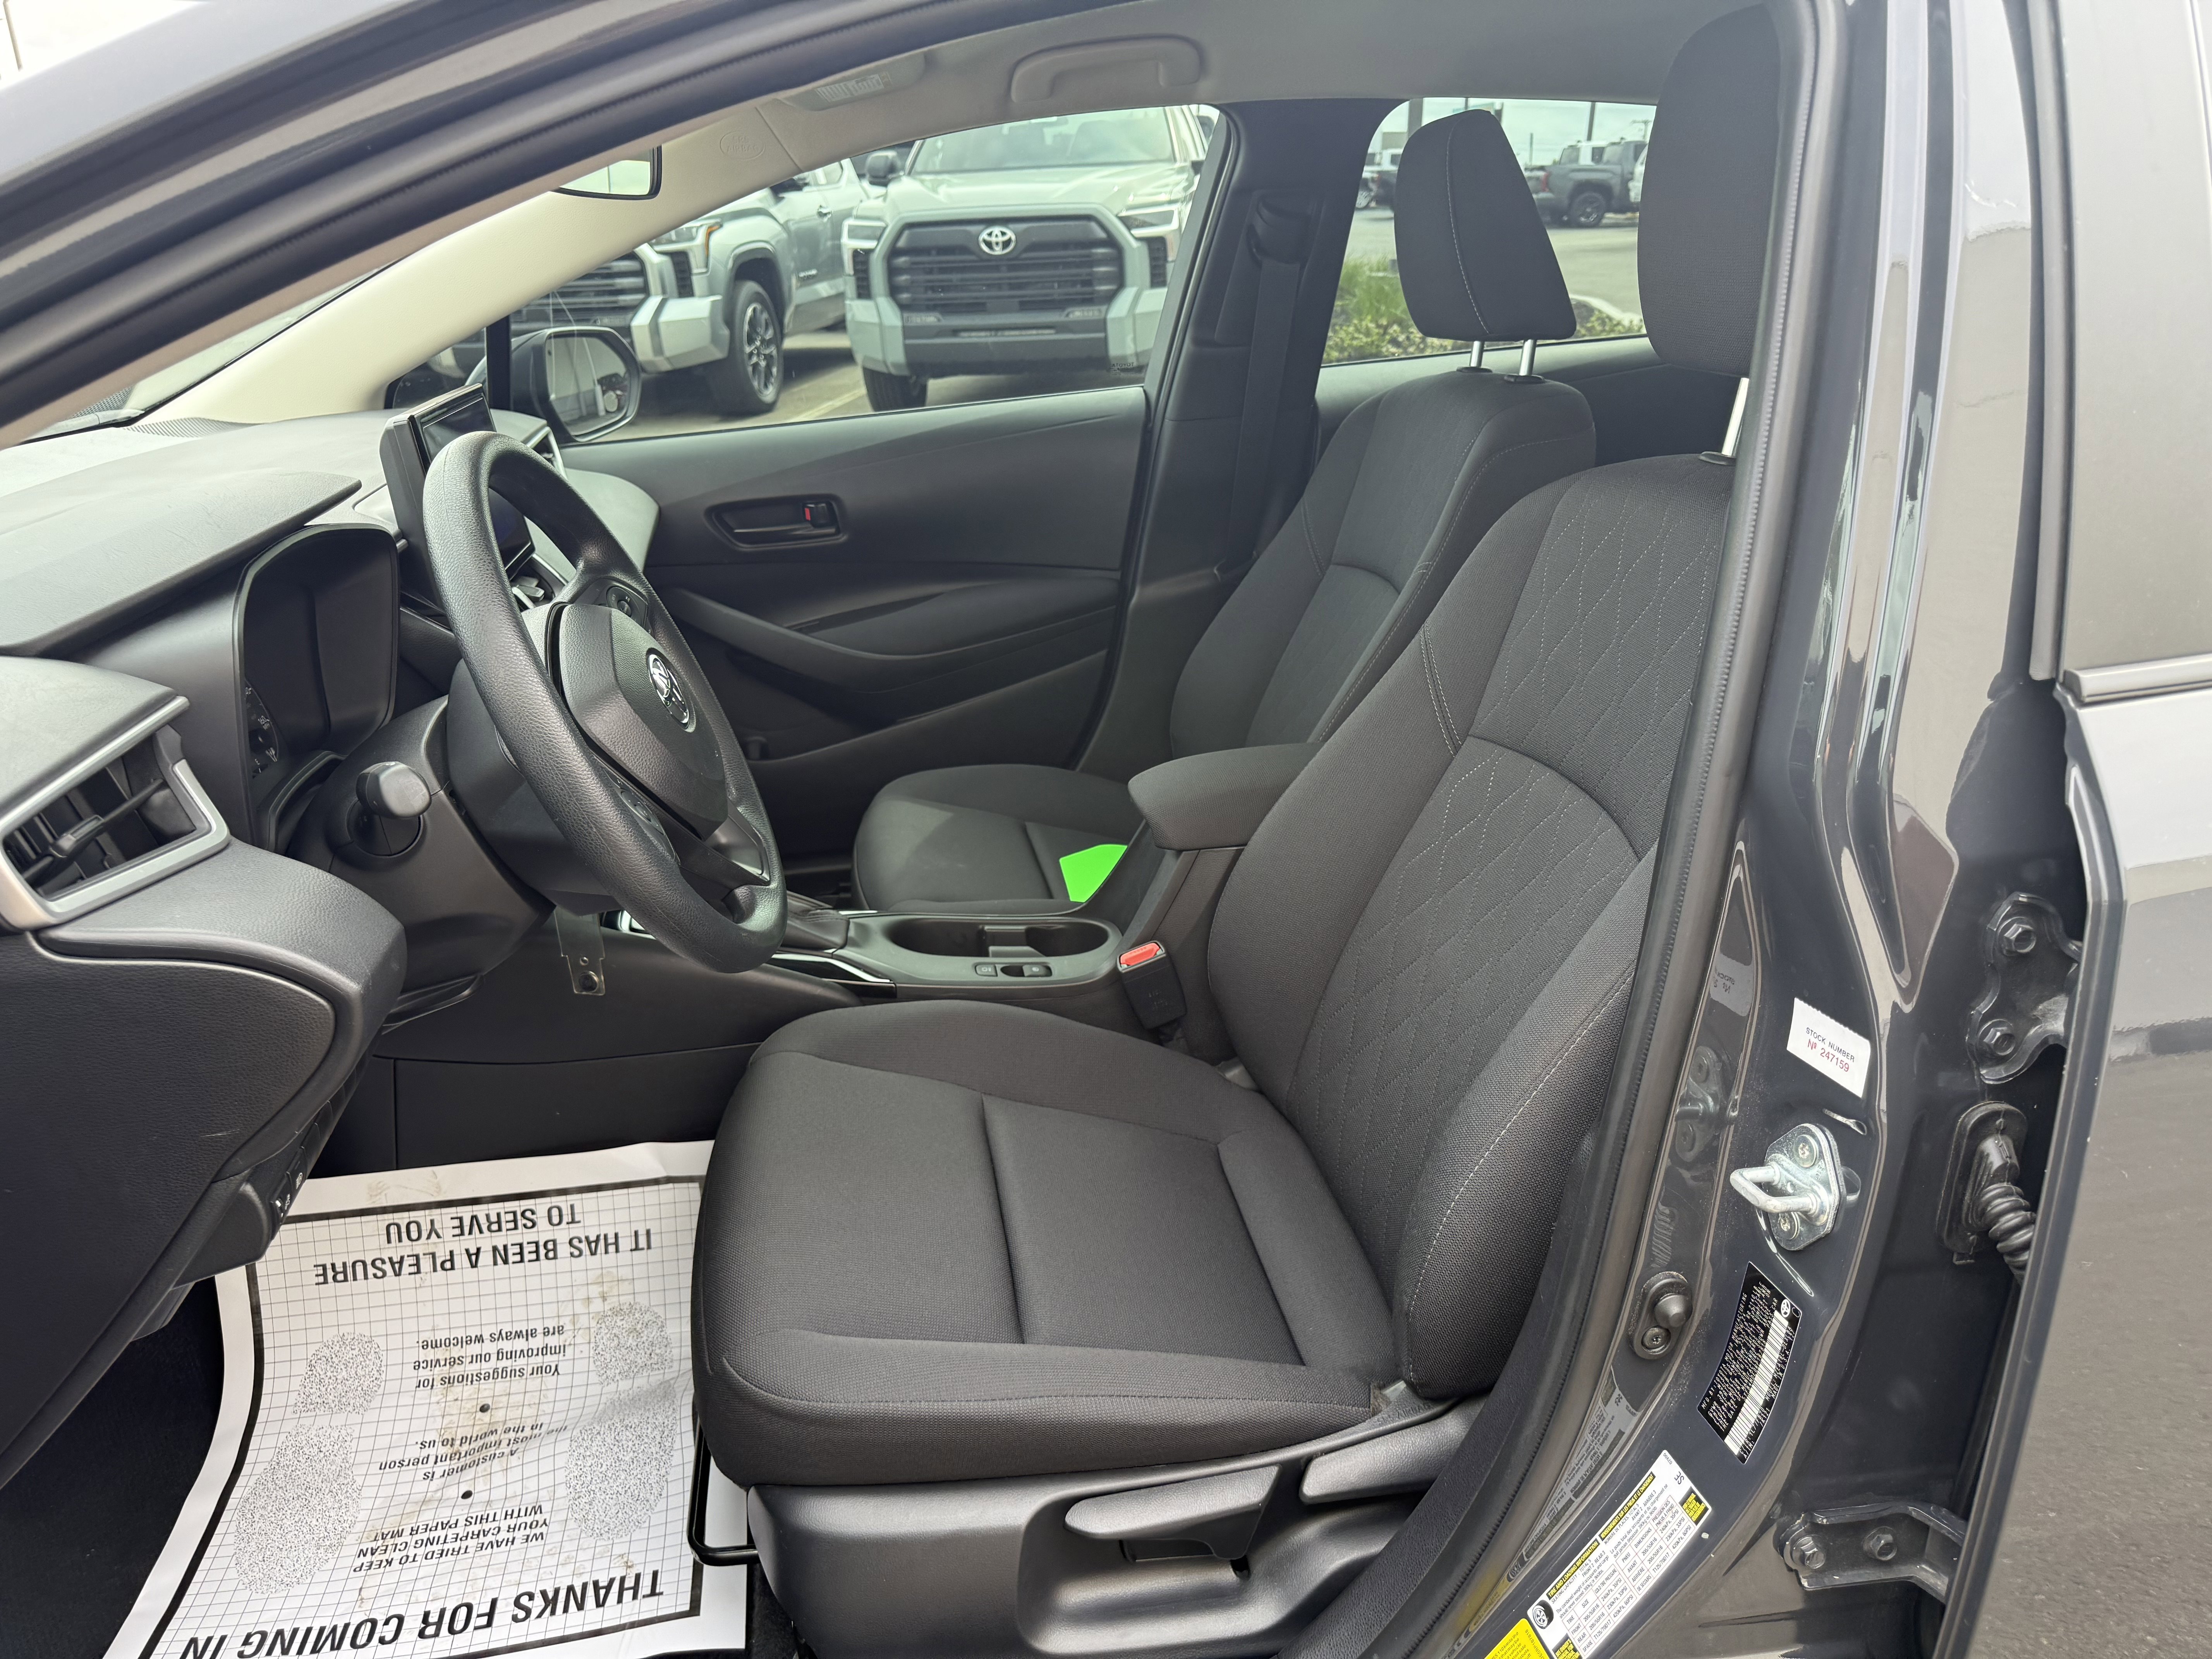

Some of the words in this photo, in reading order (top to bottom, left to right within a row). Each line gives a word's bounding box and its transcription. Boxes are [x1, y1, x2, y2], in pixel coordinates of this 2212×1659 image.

[258, 715, 270, 725] 160
[1805, 1027, 1826, 1045] STOCK
[1828, 1041, 1855, 1062] NUMBER
[1820, 1047, 1850, 1072] 247159
[450, 1208, 536, 1237] SERVE
[547, 1203, 580, 1226] TO
[384, 1218, 442, 1244] YOU
[630, 1228, 652, 1251] IT
[492, 1238, 558, 1267] BEEN
[568, 1232, 620, 1258] HAS
[313, 1249, 456, 1285] PLEASURE
[464, 1246, 482, 1269] A
[1766, 1297, 1778, 1329] PASS.CAR
[489, 1329, 537, 1343] always
[543, 1325, 564, 1336] are
[1724, 1341, 1733, 1362] MOTOR
[1731, 1291, 1747, 1341] MANUFACTURING
[416, 1333, 484, 1351] welcome.
[468, 1352, 491, 1365] our
[496, 1343, 565, 1362] improving
[412, 1356, 464, 1371] service
[529, 1364, 560, 1377] Your
[415, 1378, 434, 1389] for
[440, 1367, 525, 1387] suggestions
[1728, 1403, 1737, 1419] DATE
[503, 1425, 526, 1435] the
[530, 1422, 543, 1431] in
[415, 1439, 436, 1451] us.
[441, 1437, 455, 1448] to
[460, 1427, 498, 1448] world
[506, 1431, 542, 1447] most
[433, 1438, 502, 1465] important
[510, 1448, 519, 1456] A
[378, 1453, 430, 1470] person
[439, 1451, 505, 1479] customer
[422, 1470, 435, 1482] is
[1674, 1471, 1684, 1485] SE
[464, 1511, 498, 1527] THIS
[504, 1504, 543, 1520] WITH
[1631, 1509, 1640, 1521] AVANT
[1655, 1516, 1665, 1527] PNEUS
[1666, 1503, 1675, 1514] FROID
[372, 1527, 404, 1542] MAT
[409, 1518, 459, 1535] PAPER
[507, 1518, 548, 1533] YOUR
[1621, 1552, 1631, 1563] PNEU
[1634, 1527, 1652, 1549] DIMENSIONS
[1651, 1506, 1666, 1522] PRESSION
[414, 1525, 501, 1548] CARPETING
[475, 1536, 516, 1552] HAVE
[521, 1532, 544, 1544] WE
[1604, 1531, 1615, 1545] NOMBRE
[1626, 1559, 1638, 1573] AVANT
[1641, 1537, 1657, 1556] 205/55R16
[1669, 1508, 1679, 1520] 35PSI
[357, 1540, 409, 1558] CLEAN
[424, 1545, 470, 1560] TRIED
[1630, 1565, 1645, 1582] ARRIÈRE
[1647, 1544, 1663, 1564] 205/55R16
[1676, 1516, 1685, 1528] 33PSI
[1640, 1574, 1652, 1587] SECOURS
[1652, 1552, 1670, 1573] T125/70D17
[1681, 1524, 1692, 1536] 60PSI
[353, 1558, 394, 1572] KEEP
[398, 1553, 417, 1565] TO
[1548, 1586, 1557, 1597] TIRE
[1555, 1579, 1564, 1590] AND
[1562, 1563, 1578, 1582] LOADING
[1575, 1539, 1599, 1567] INFORMATION
[1581, 1565, 1592, 1578] FRONT
[1594, 1553, 1603, 1563] REAR
[1561, 1593, 1574, 1609] combined
[1573, 1584, 1583, 1597] weight
[1583, 1568, 1597, 1584] occupants
[1601, 1555, 1609, 1565] cargo
[511, 1569, 663, 1623] THANKS
[1559, 1607, 1568, 1619] should
[1567, 1600, 1575, 1610] never
[1574, 1590, 1584, 1602] exceed
[1566, 1614, 1575, 1625] TIRE
[1581, 1598, 1589, 1608] SIZE
[1604, 1568, 1617, 1583] PRESSURE
[1571, 1623, 1582, 1636] FRONT
[1583, 1602, 1600, 1623] 205/55R16
[1612, 1577, 1622, 1589] 35PSI
[1577, 1632, 1587, 1643] REAR
[1588, 1611, 1605, 1631] 205/55R16
[1618, 1585, 1628, 1597] 33PSI
[417, 1597, 498, 1640] FOR
[1582, 1639, 1593, 1653] SPARE
[1594, 1618, 1612, 1640] T125/70D17
[1623, 1594, 1633, 1606] 60PSI
[237, 1613, 405, 1659] COMING
[1503, 1638, 1513, 1649] limits
[179, 1634, 228, 1659] IN
[1506, 1644, 1515, 1652] may
[1509, 1642, 1522, 1657] vehicle
